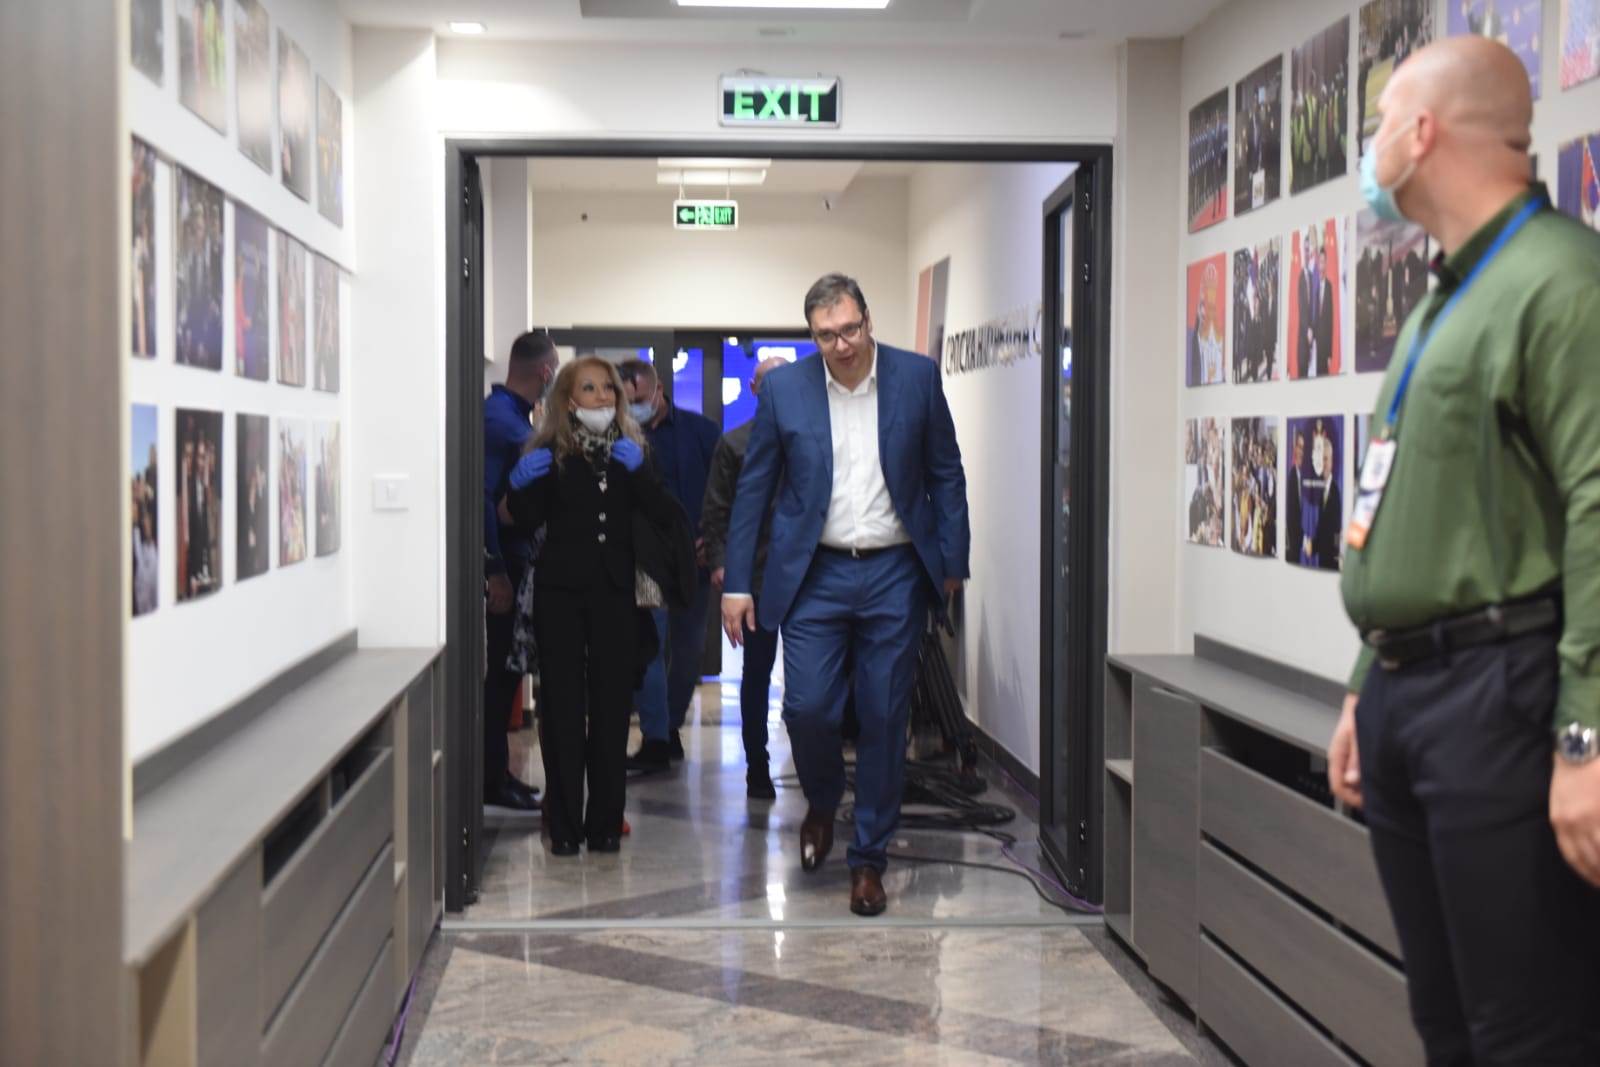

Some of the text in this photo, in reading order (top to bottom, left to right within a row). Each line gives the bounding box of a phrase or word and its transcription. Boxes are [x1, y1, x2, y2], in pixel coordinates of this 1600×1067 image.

[734, 84, 828, 120] EXIT
[714, 207, 733, 224] EXIT
[945, 328, 976, 375] СРПСКА
